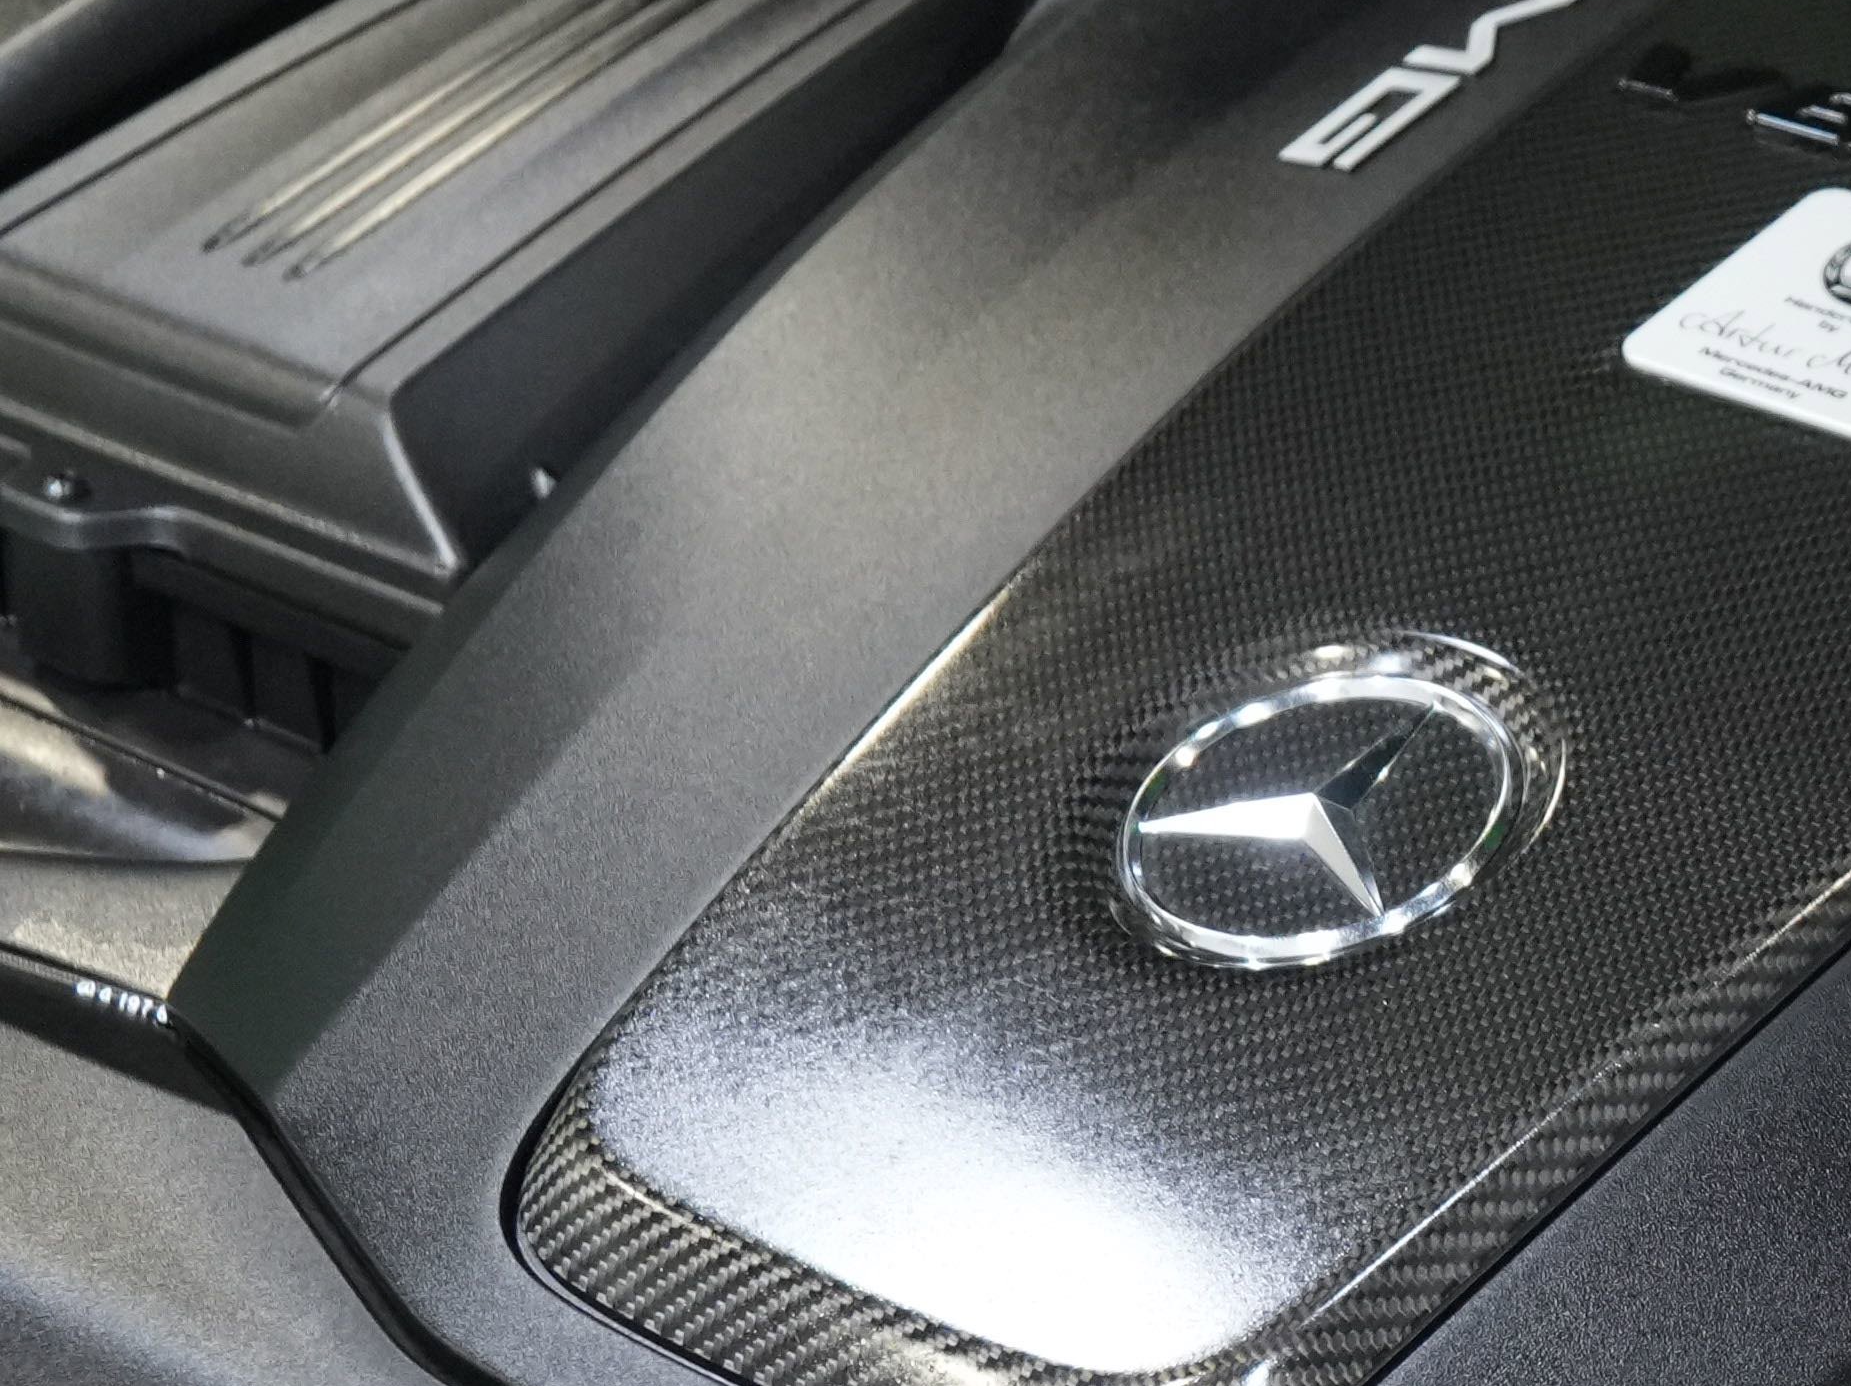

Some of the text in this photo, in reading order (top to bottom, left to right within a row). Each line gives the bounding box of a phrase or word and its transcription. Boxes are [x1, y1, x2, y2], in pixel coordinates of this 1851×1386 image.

[1678, 309, 1799, 358] Artur
[1817, 319, 1840, 333] by
[1698, 346, 1849, 400] Mercedes-AMG
[1718, 366, 1801, 399] Germany
